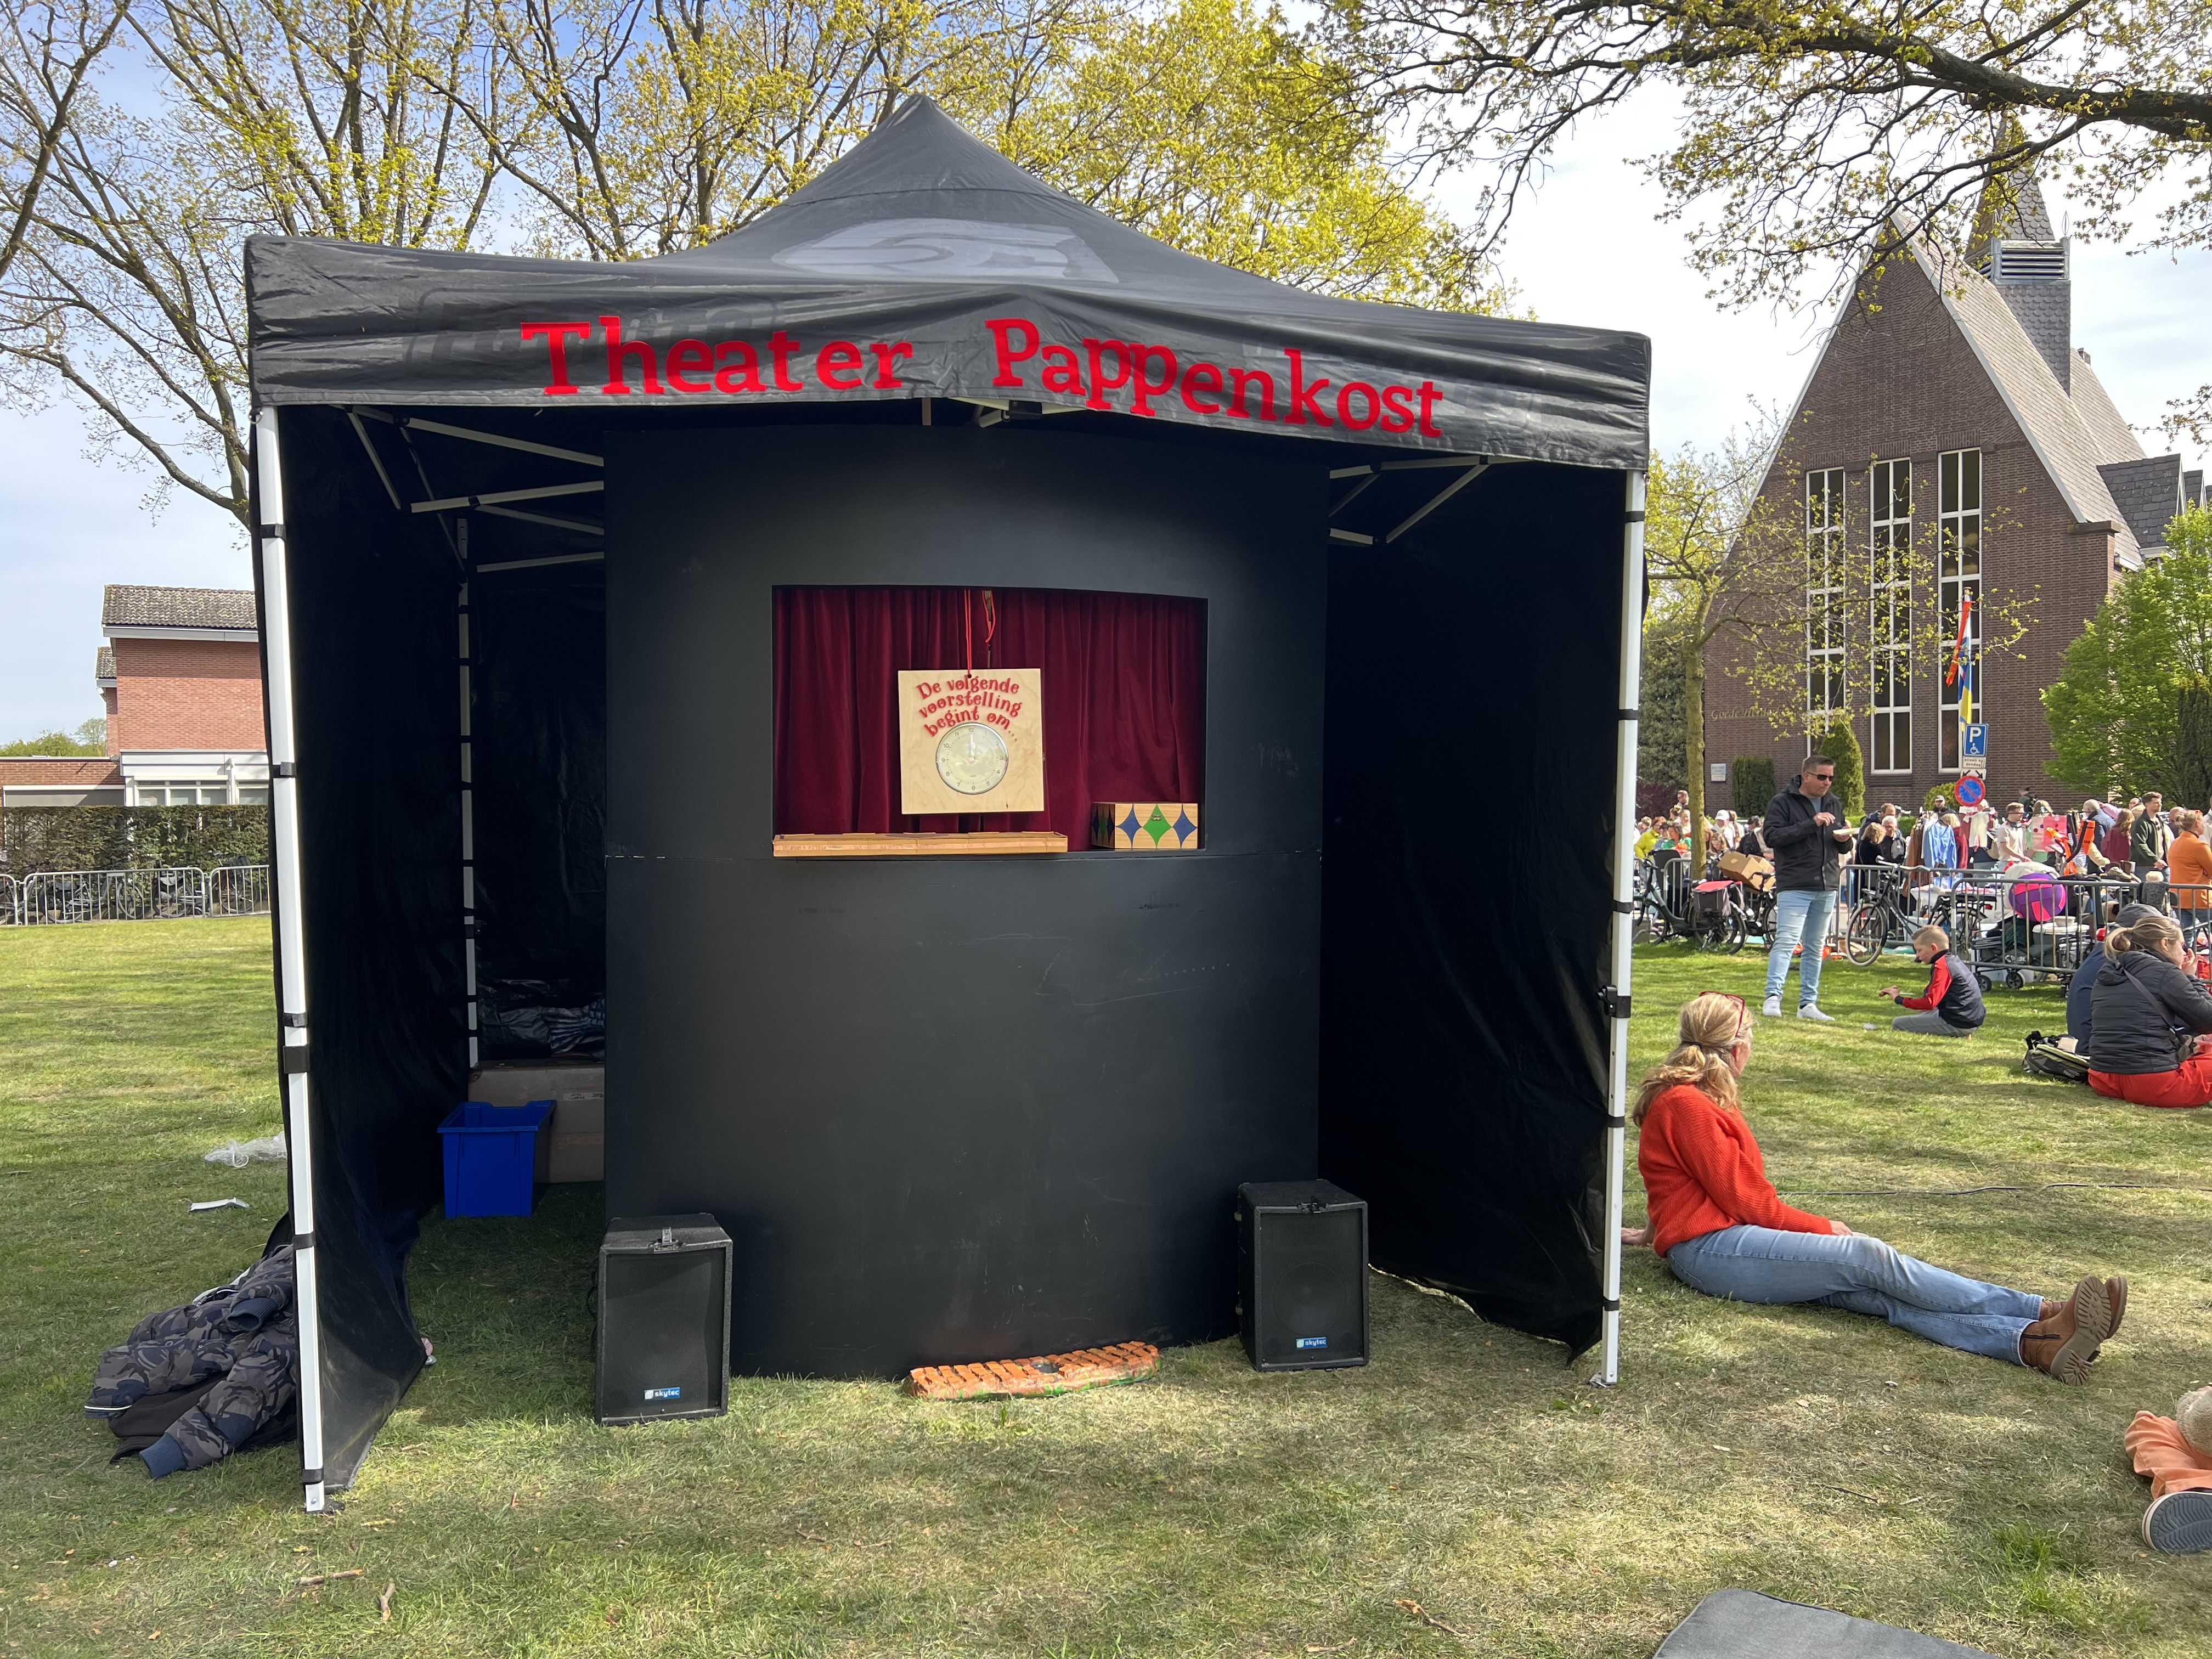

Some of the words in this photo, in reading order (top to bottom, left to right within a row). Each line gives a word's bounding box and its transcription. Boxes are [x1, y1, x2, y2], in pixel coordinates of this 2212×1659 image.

[521, 316, 913, 394] Theater
[985, 318, 1443, 438] Pappenkost
[916, 682, 941, 699] De
[947, 675, 1019, 694] volgende
[919, 691, 1023, 718] voorstelling
[924, 706, 979, 737] begint
[1970, 727, 1982, 742] P
[654, 1389, 679, 1397] skytec
